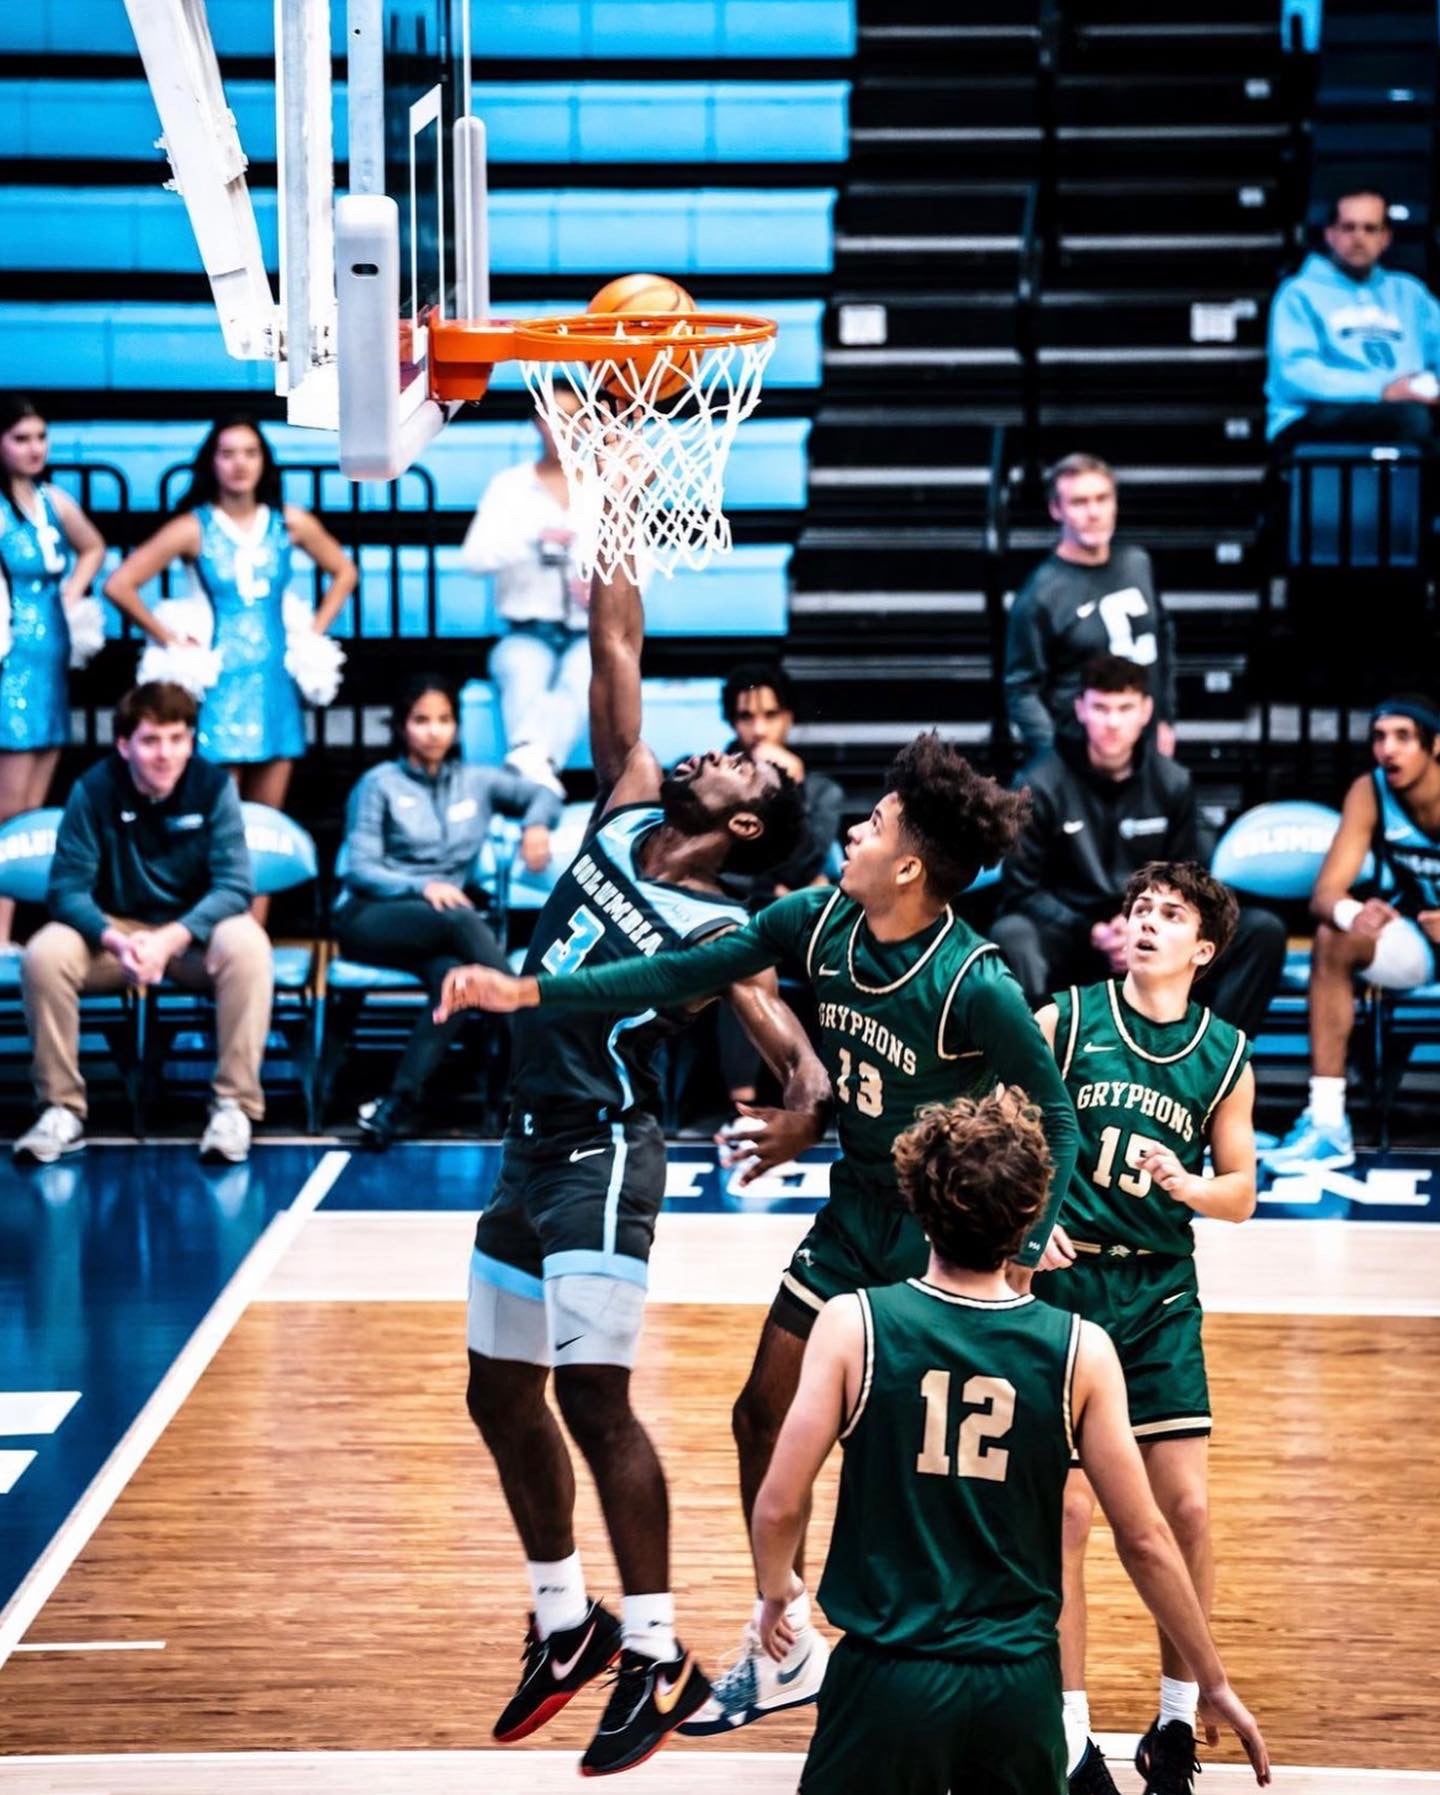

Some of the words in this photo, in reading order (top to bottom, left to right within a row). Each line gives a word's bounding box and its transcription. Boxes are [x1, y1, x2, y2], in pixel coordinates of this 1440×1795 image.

[1100, 587, 1157, 666] C
[541, 904, 606, 976] 3
[836, 1047, 884, 1118] 13
[1076, 1081, 1194, 1143] GRYPHONS
[1092, 1125, 1160, 1199] 15
[916, 1369, 1017, 1482] 12
